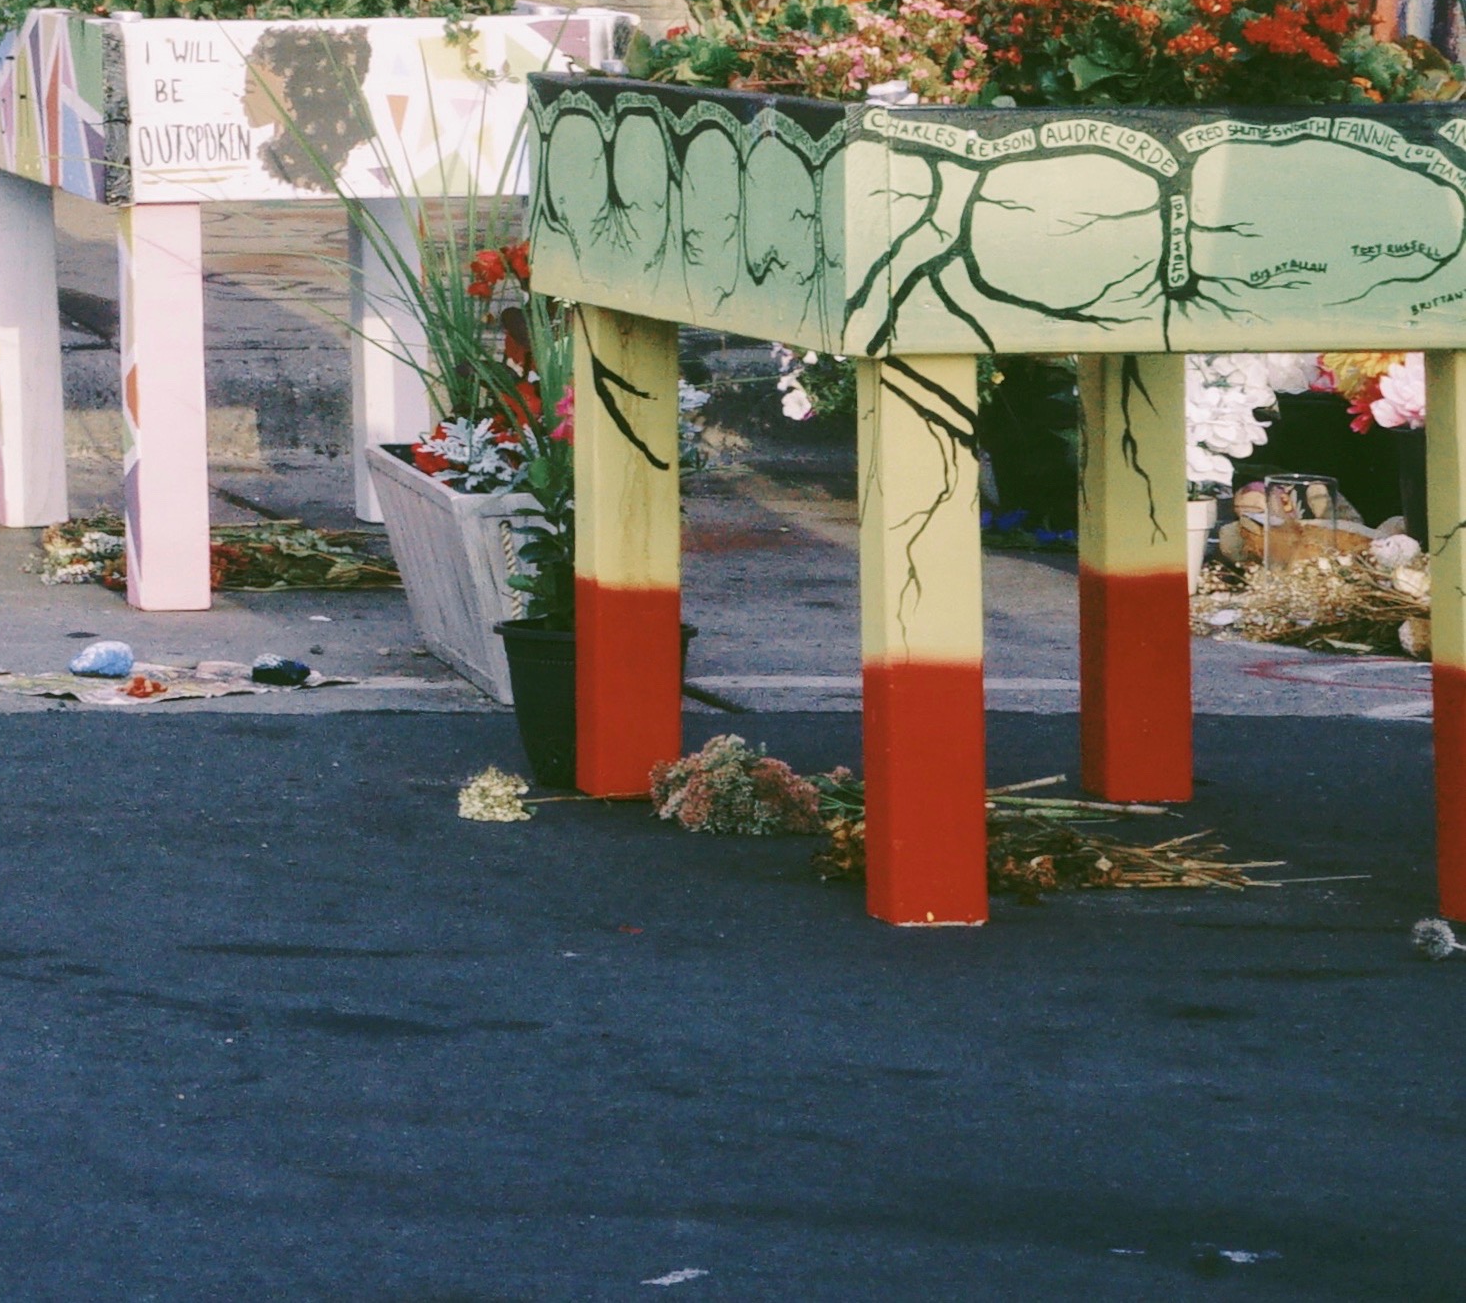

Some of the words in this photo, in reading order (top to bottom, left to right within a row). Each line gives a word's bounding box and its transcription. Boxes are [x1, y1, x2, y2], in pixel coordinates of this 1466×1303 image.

[170, 38, 220, 65] WILL
[154, 78, 184, 104] BE
[870, 111, 958, 148] CHARLES
[1045, 123, 1114, 144] AUDRE
[1184, 124, 1225, 149] FRED
[1336, 120, 1400, 153] FANNIE
[137, 122, 251, 168] OUTSPOKEN
[1171, 197, 1186, 221] IDA
